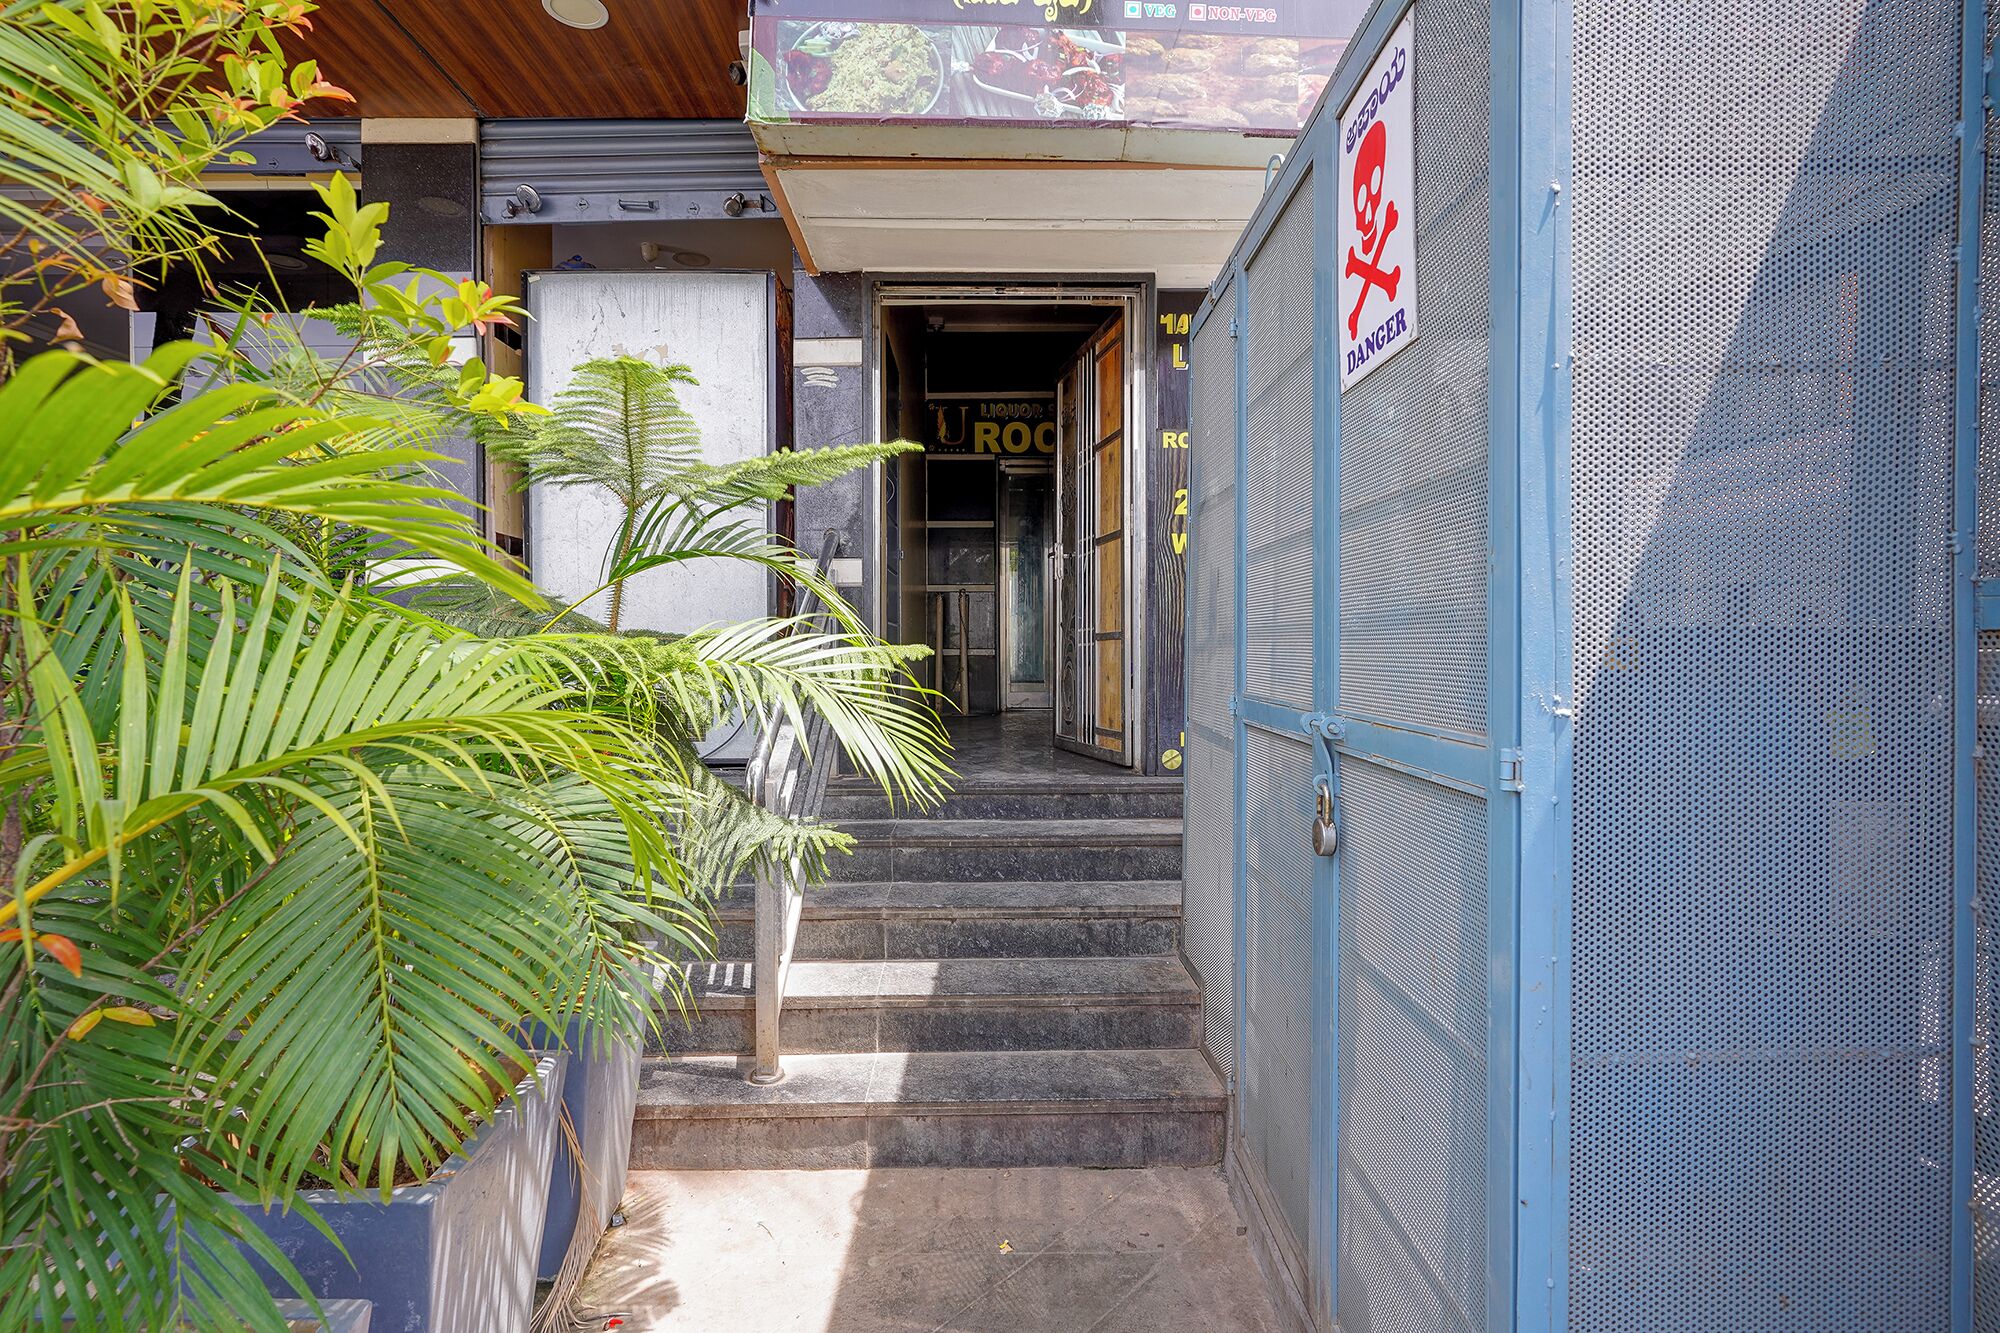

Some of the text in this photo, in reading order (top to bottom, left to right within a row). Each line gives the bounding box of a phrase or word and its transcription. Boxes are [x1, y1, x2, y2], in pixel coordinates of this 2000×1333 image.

[1144, 4, 1176, 18] VEG
[1208, 6, 1277, 22] NON-VEG
[1346, 46, 1406, 154] ಅಪಾಯ
[1347, 307, 1408, 376] DANGER
[980, 403, 1043, 419] LIQUOR
